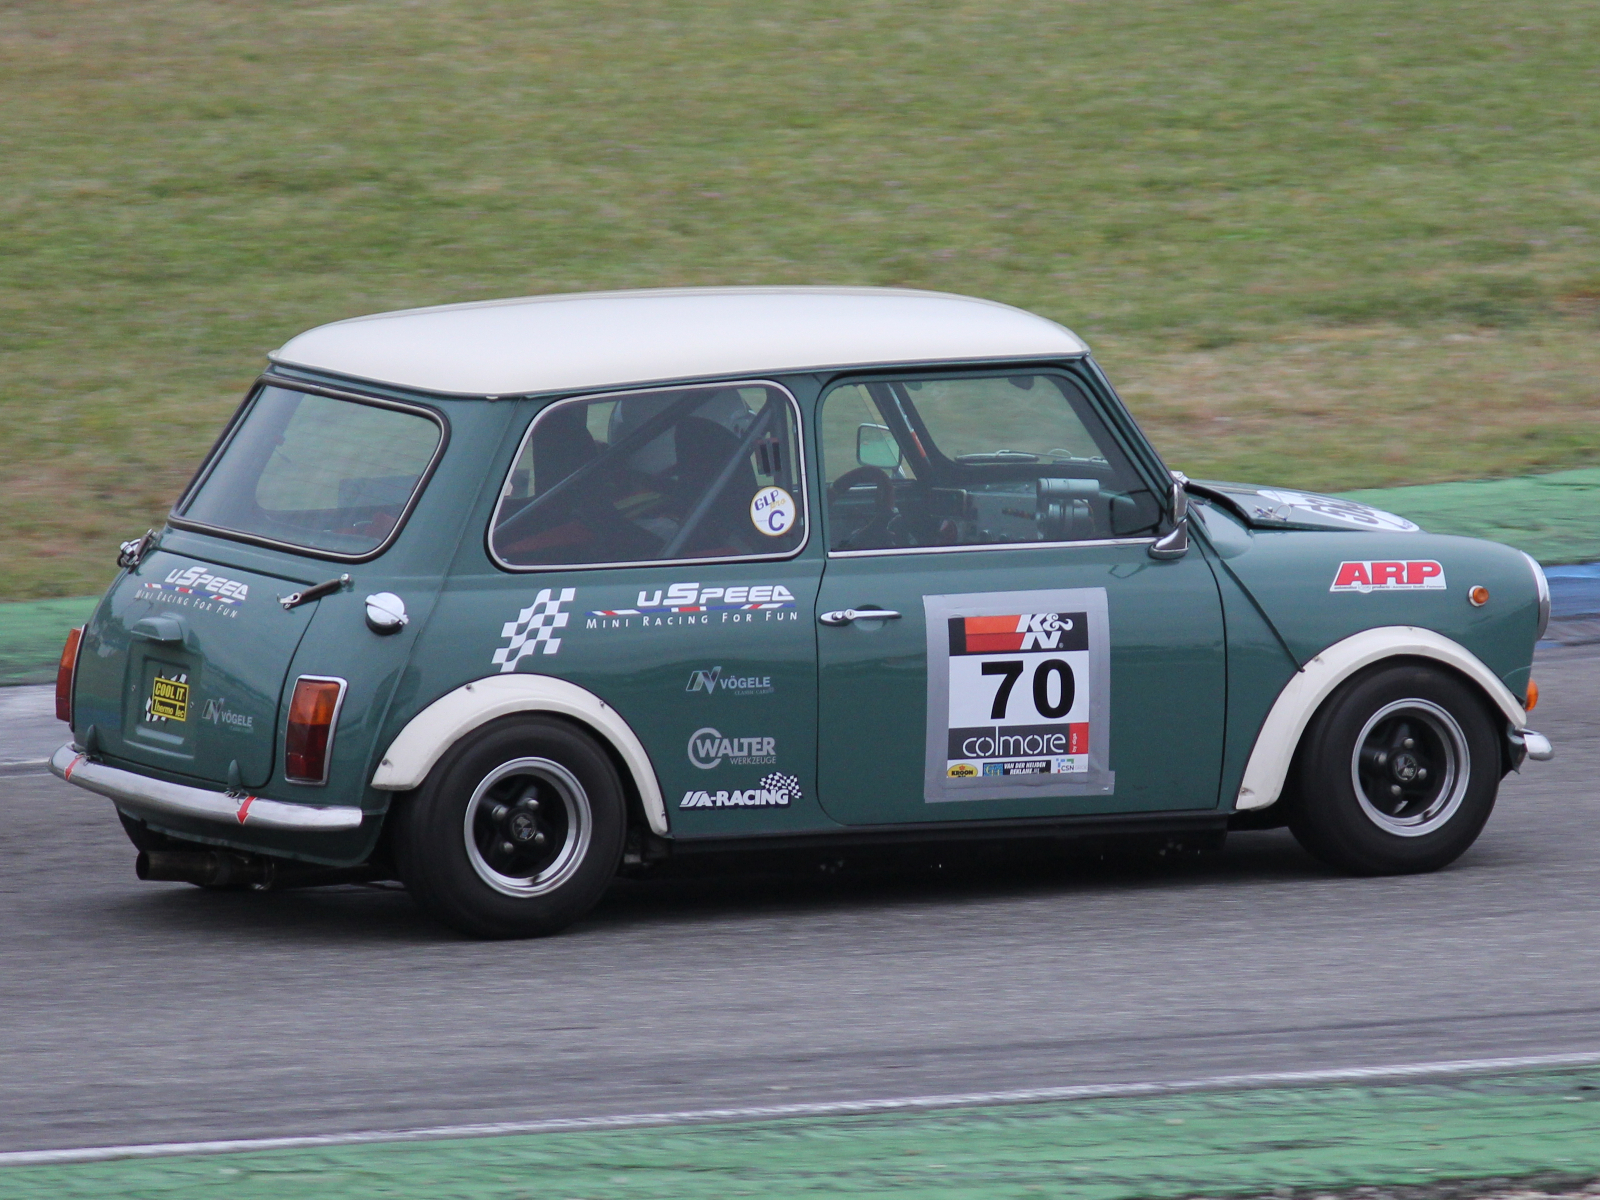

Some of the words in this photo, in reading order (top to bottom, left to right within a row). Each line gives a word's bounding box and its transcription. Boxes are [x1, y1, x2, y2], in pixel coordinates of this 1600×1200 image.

[754, 489, 779, 511] GLP
[768, 509, 785, 532] C
[1335, 561, 1442, 586] ARP
[135, 589, 154, 600] MINI
[156, 591, 189, 606] RACING
[193, 598, 212, 611] FOR
[216, 604, 238, 618] FUN
[586, 617, 630, 629] MINI
[642, 614, 709, 627] RACING
[722, 612, 753, 623] FOR
[765, 610, 798, 622] FUN
[155, 682, 175, 699] COOL
[175, 687, 186, 700] IT
[720, 675, 771, 689] VÖGELE
[981, 658, 1076, 719] 70
[221, 710, 253, 727] VÖGELE
[696, 737, 777, 758] WALTER
[963, 726, 1066, 757] colmore
[730, 756, 777, 765] WERKZEUGE
